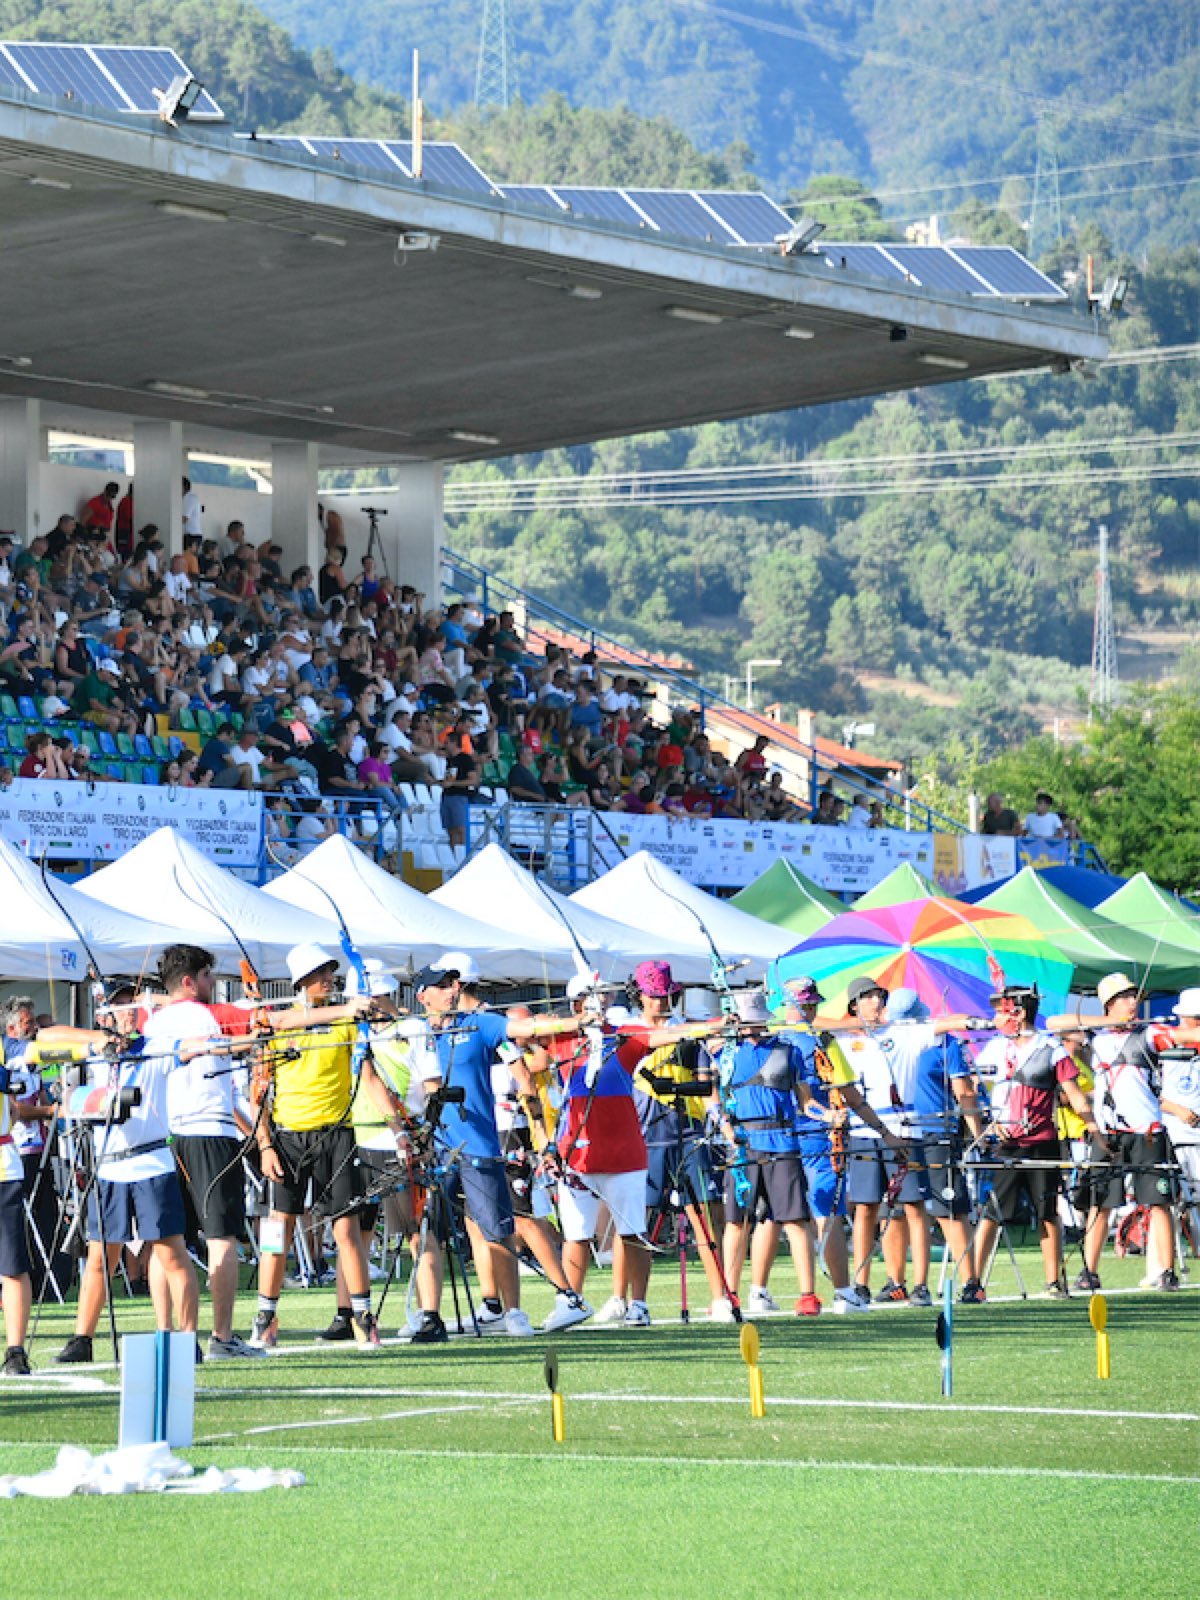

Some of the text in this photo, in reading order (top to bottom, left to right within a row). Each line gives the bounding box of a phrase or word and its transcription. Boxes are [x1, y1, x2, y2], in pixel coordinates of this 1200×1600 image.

[17, 810, 96, 825] FEDERAZIONE ITALIANA
[102, 814, 178, 828] FEDERAZIONE ITALIANA
[29, 824, 45, 836] TIRO
[46, 826, 63, 837] CON
[230, 820, 257, 832] ITALIANA
[113, 828, 130, 840] TIRO
[195, 832, 211, 843] TIRO
